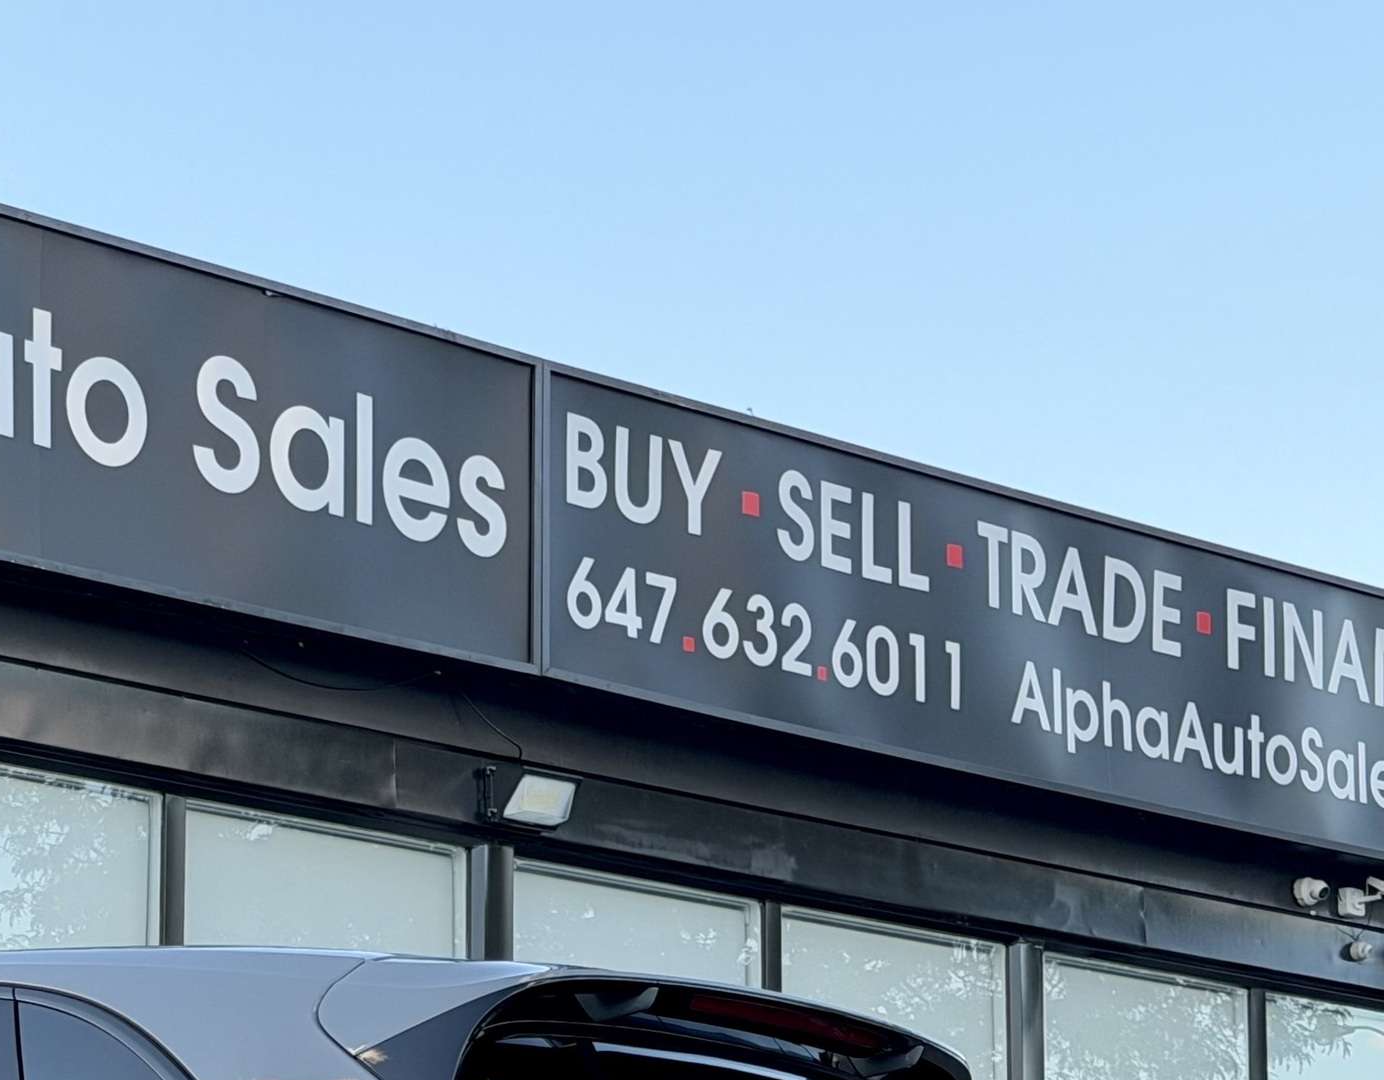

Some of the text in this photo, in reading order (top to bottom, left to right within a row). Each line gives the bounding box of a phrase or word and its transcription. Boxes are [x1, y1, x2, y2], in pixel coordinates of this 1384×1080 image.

[193, 355, 507, 558] Sales
[566, 411, 1384, 707] BUY SELL TRADE FINA
[567, 556, 962, 711] 647.632.6011
